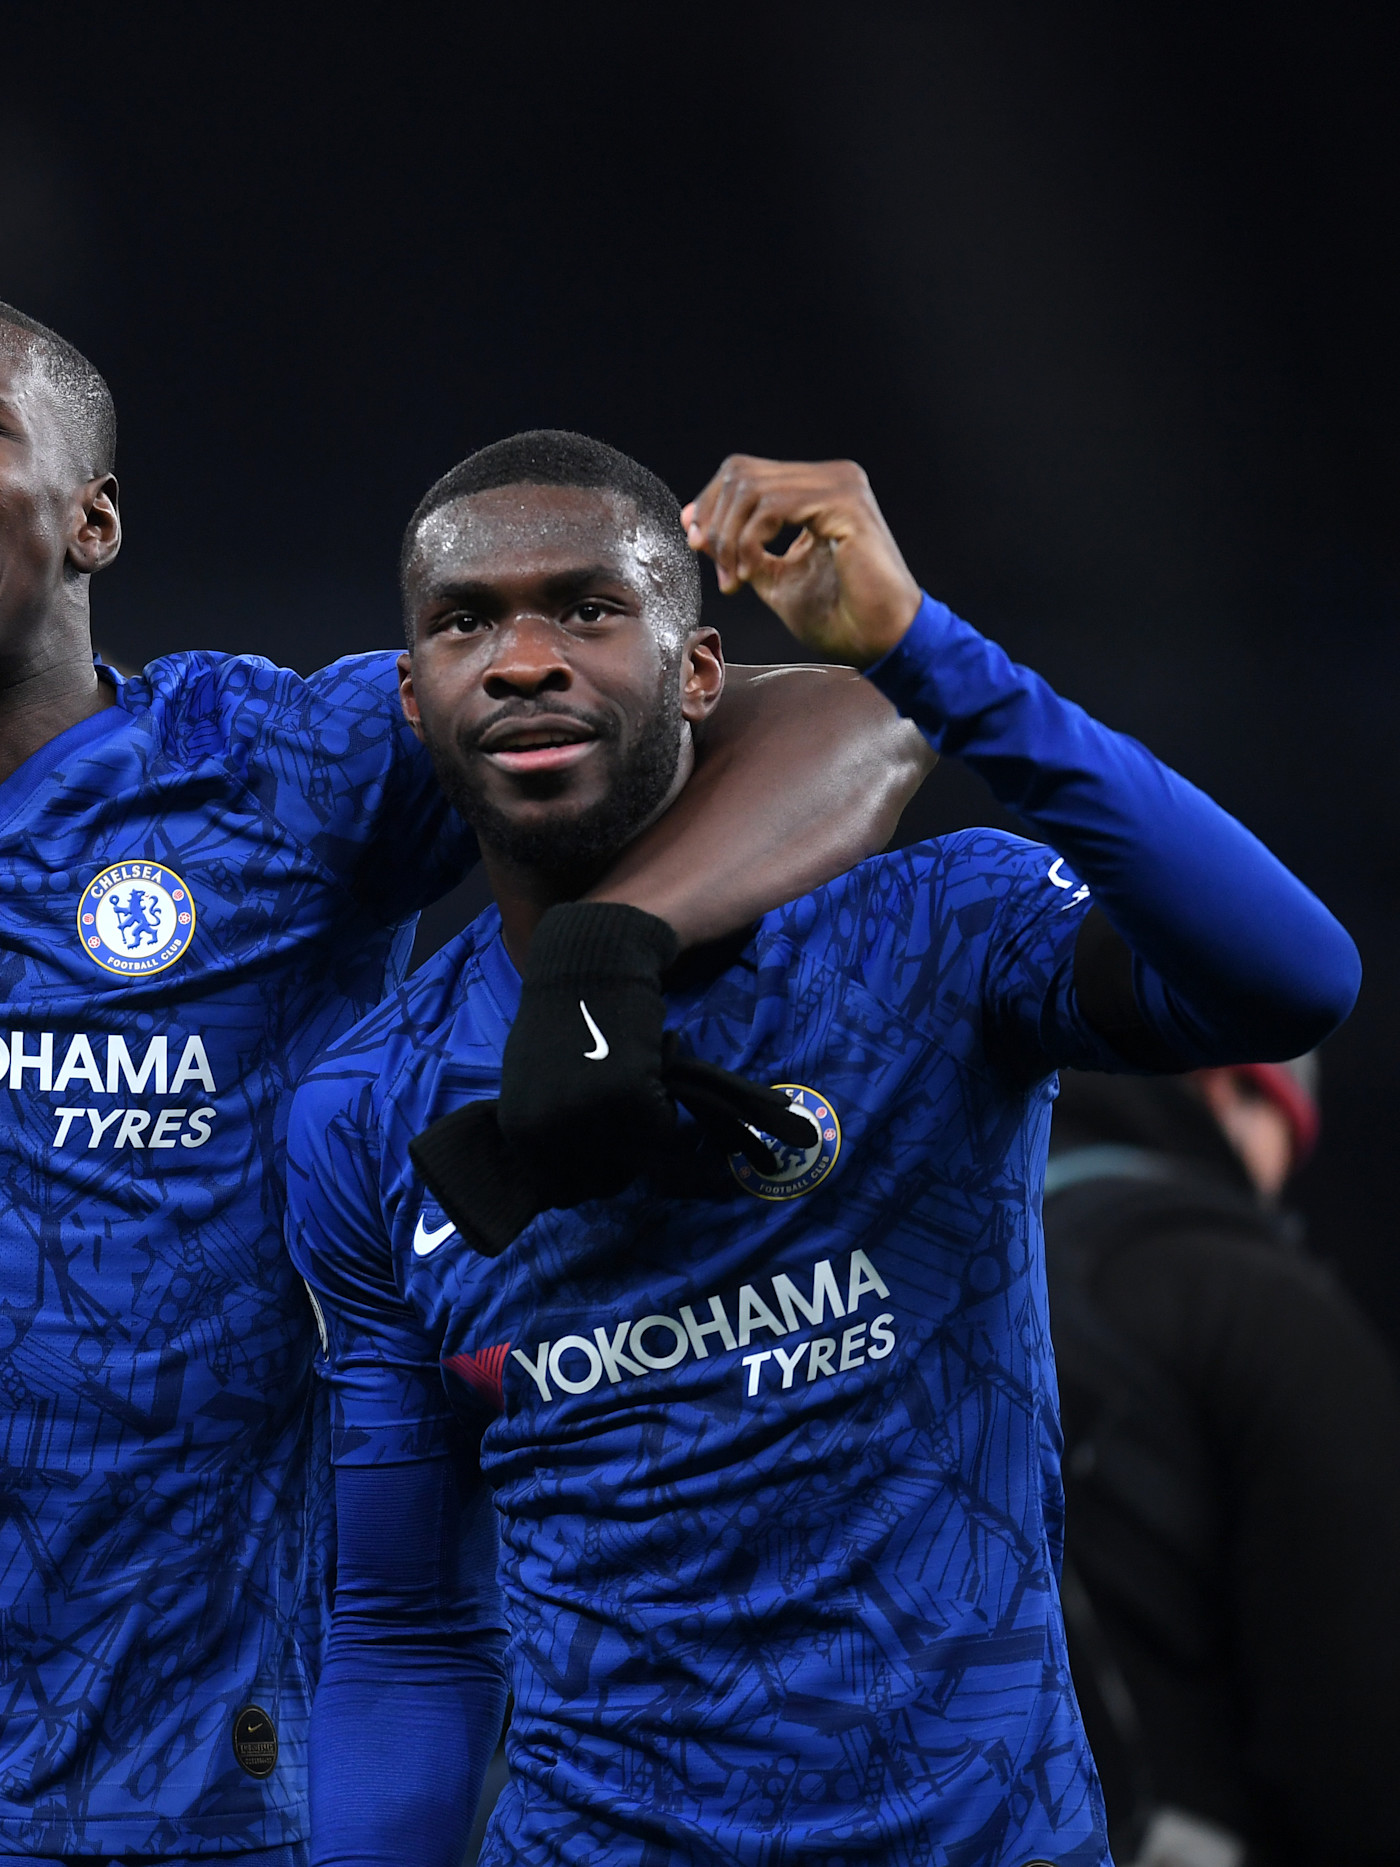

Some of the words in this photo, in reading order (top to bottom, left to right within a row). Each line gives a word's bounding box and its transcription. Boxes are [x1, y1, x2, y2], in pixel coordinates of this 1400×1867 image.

[90, 865, 163, 899] CHELSEA
[107, 956, 159, 970] FOOTBALL
[161, 939, 182, 960] CLUB
[52, 1107, 217, 1149] TYRES
[759, 1179, 809, 1194] FOOTBALL
[811, 1155, 830, 1179] CLUB
[511, 1249, 891, 1402] YOKOHAMA
[741, 1313, 896, 1397] TYRES
